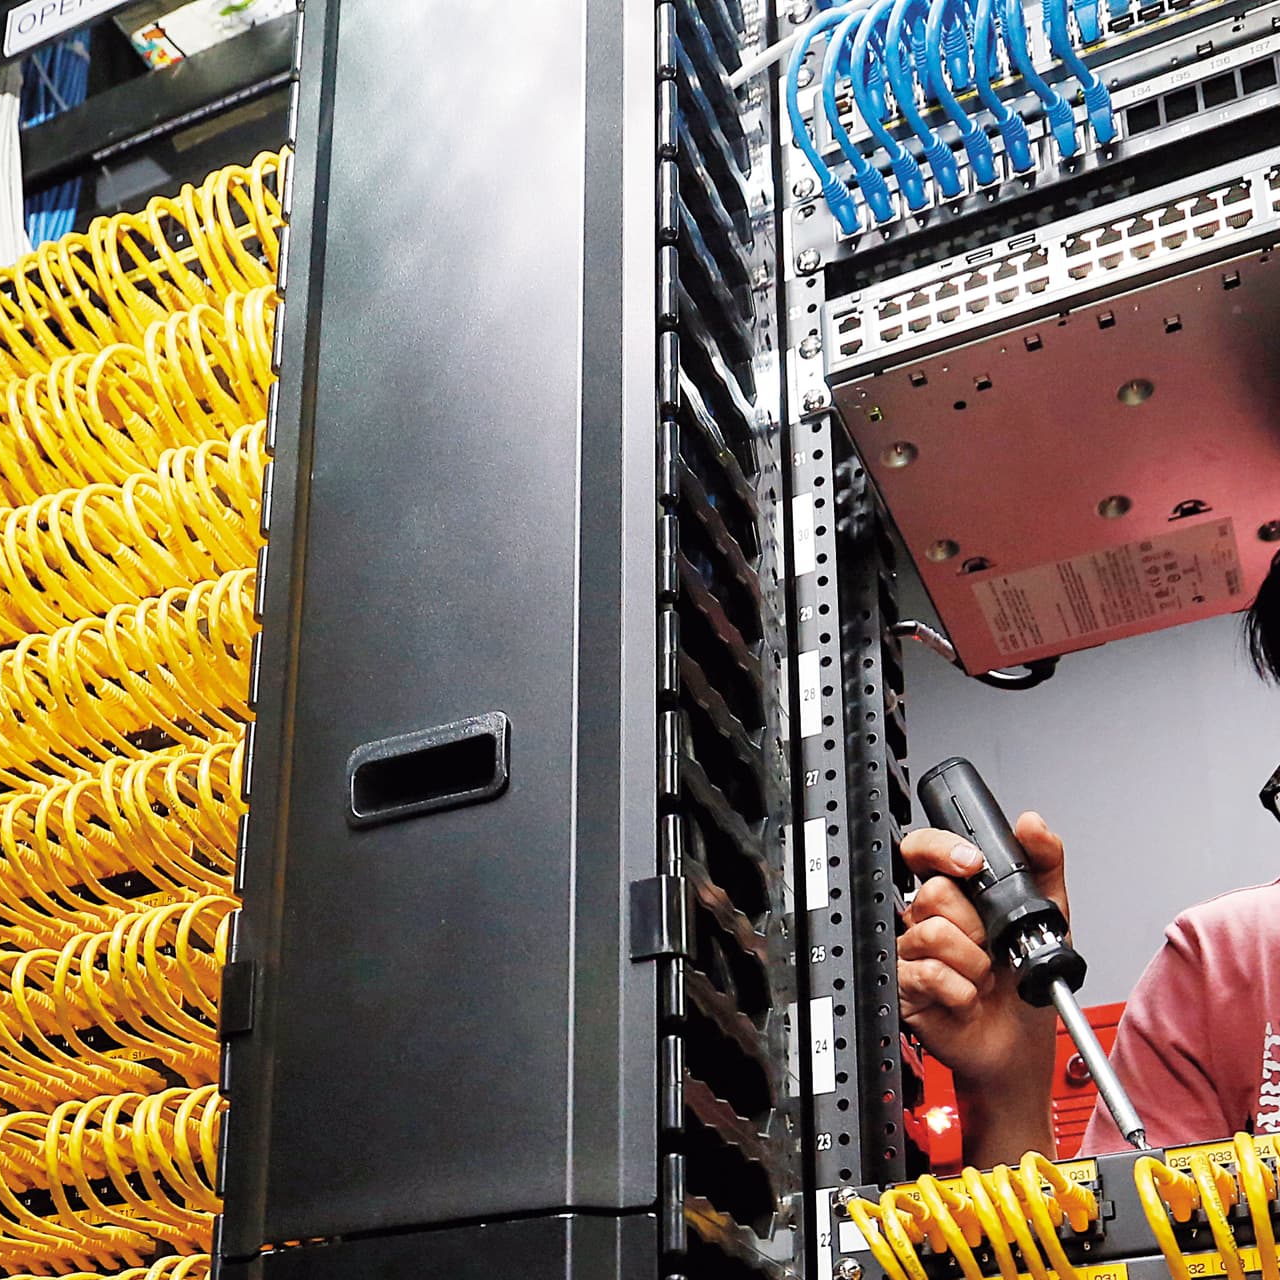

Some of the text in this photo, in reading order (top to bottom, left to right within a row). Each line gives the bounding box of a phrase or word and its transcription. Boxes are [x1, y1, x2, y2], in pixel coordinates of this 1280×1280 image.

[797, 529, 809, 542] 30
[800, 607, 813, 622] 29
[803, 687, 816, 702] 28
[806, 770, 819, 786] 27
[809, 858, 822, 872] 26
[812, 946, 826, 962] 25
[815, 1040, 828, 1054] 24
[817, 1133, 832, 1150] 23
[1070, 1168, 1091, 1181] Q31
